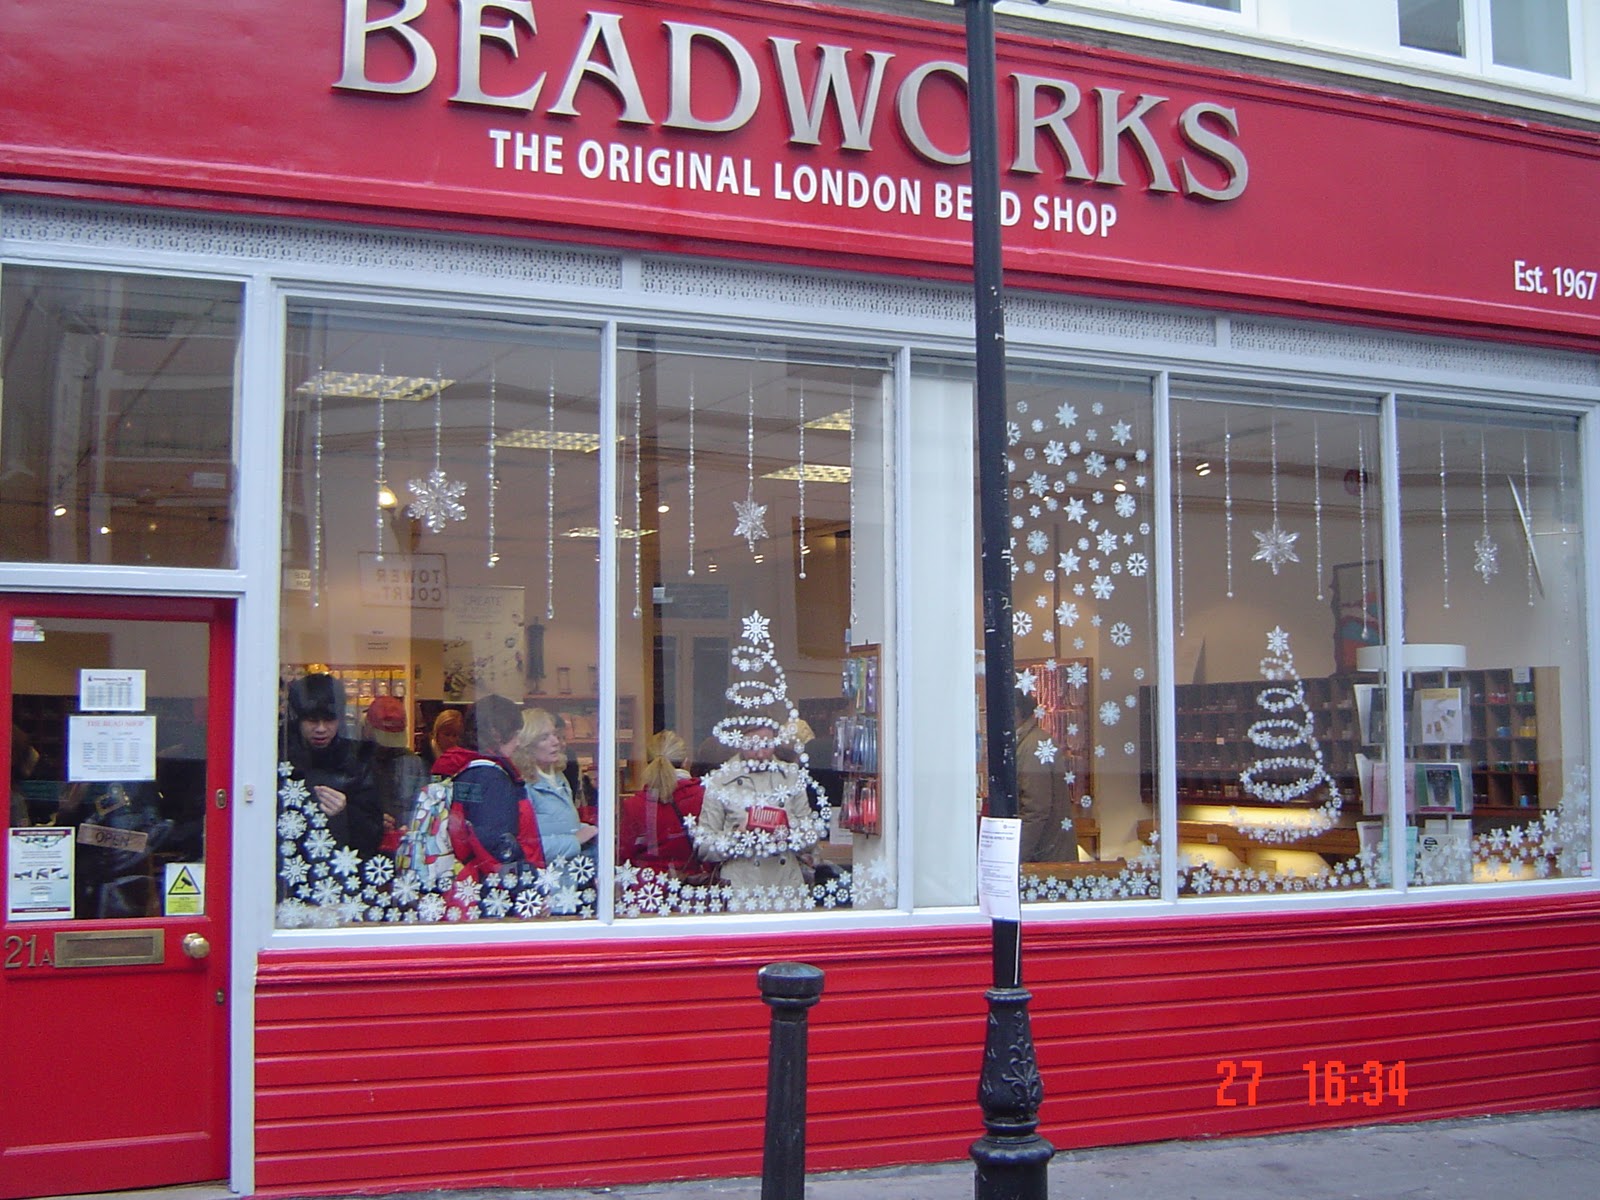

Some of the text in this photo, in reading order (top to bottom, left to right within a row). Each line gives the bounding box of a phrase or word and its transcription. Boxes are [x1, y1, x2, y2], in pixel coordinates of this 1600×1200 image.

[331, 0, 1249, 203] BEADWORKS
[489, 129, 1117, 238] THE ORIGINAL LONDON BED SHOP
[1514, 260, 1598, 300] Est. 1967
[95, 831, 130, 847] OPEN
